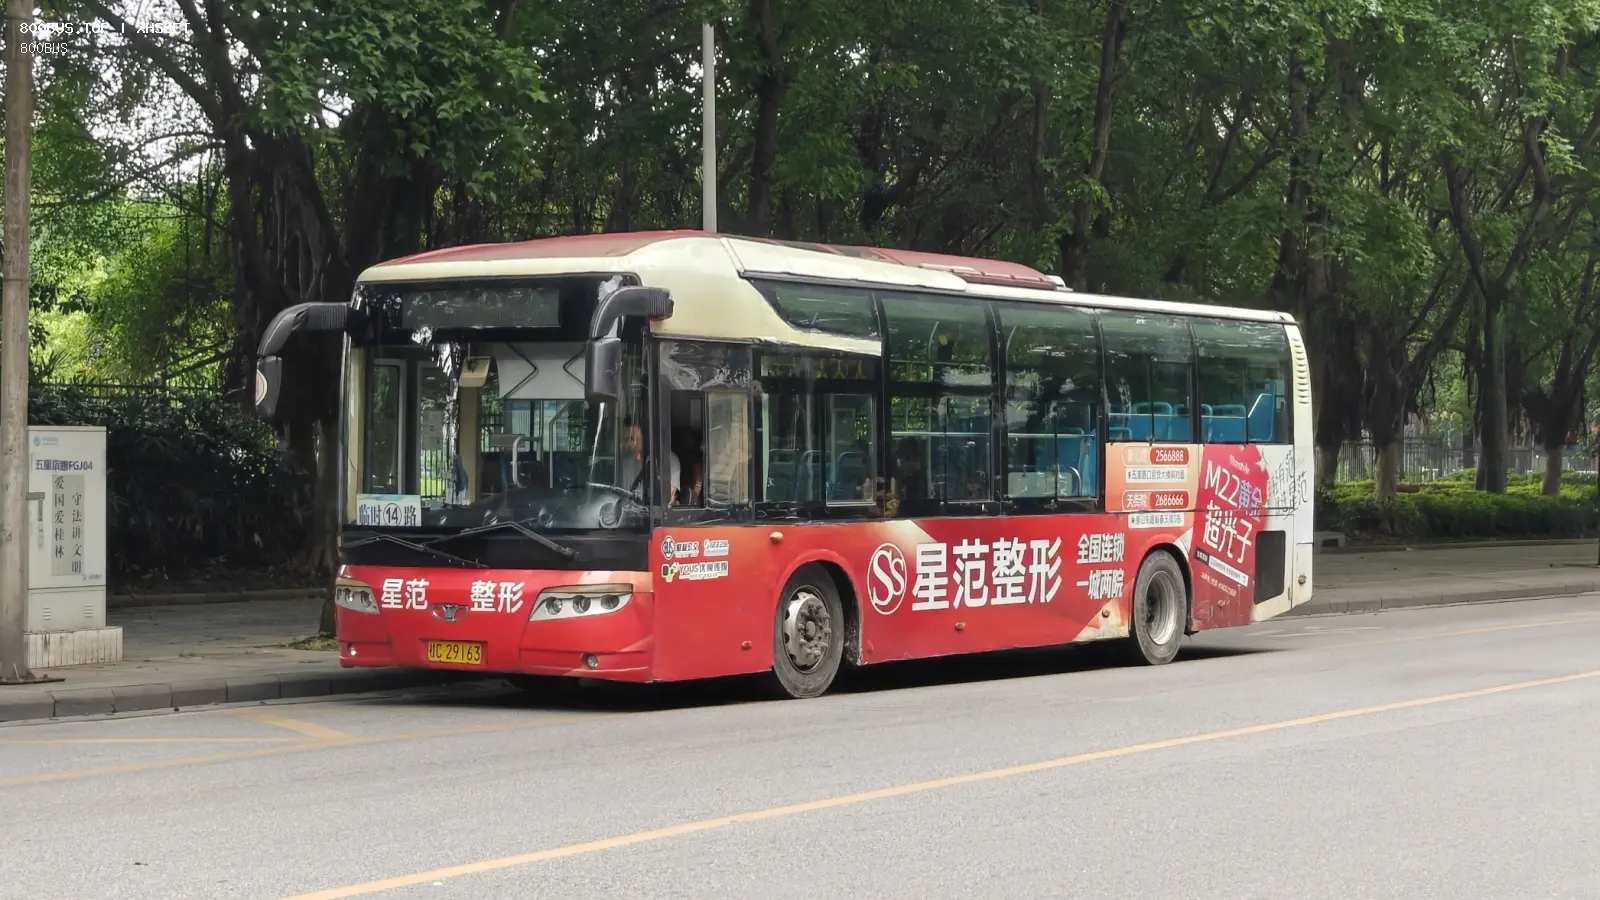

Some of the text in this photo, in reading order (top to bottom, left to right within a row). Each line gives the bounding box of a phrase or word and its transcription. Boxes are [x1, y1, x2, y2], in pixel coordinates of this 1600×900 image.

[1155, 449, 1184, 462] 2566888
[54, 475, 65, 560] 爱国爱桂林
[1155, 493, 1184, 507] 2686666
[71, 492, 83, 574] 守法讲文明
[1076, 533, 1125, 564] 全国连锁
[1203, 499, 1252, 564] 超光子
[912, 536, 1063, 611] 星范整形
[1076, 568, 1124, 600] 一城两院
[381, 578, 525, 614] 星范 整形
